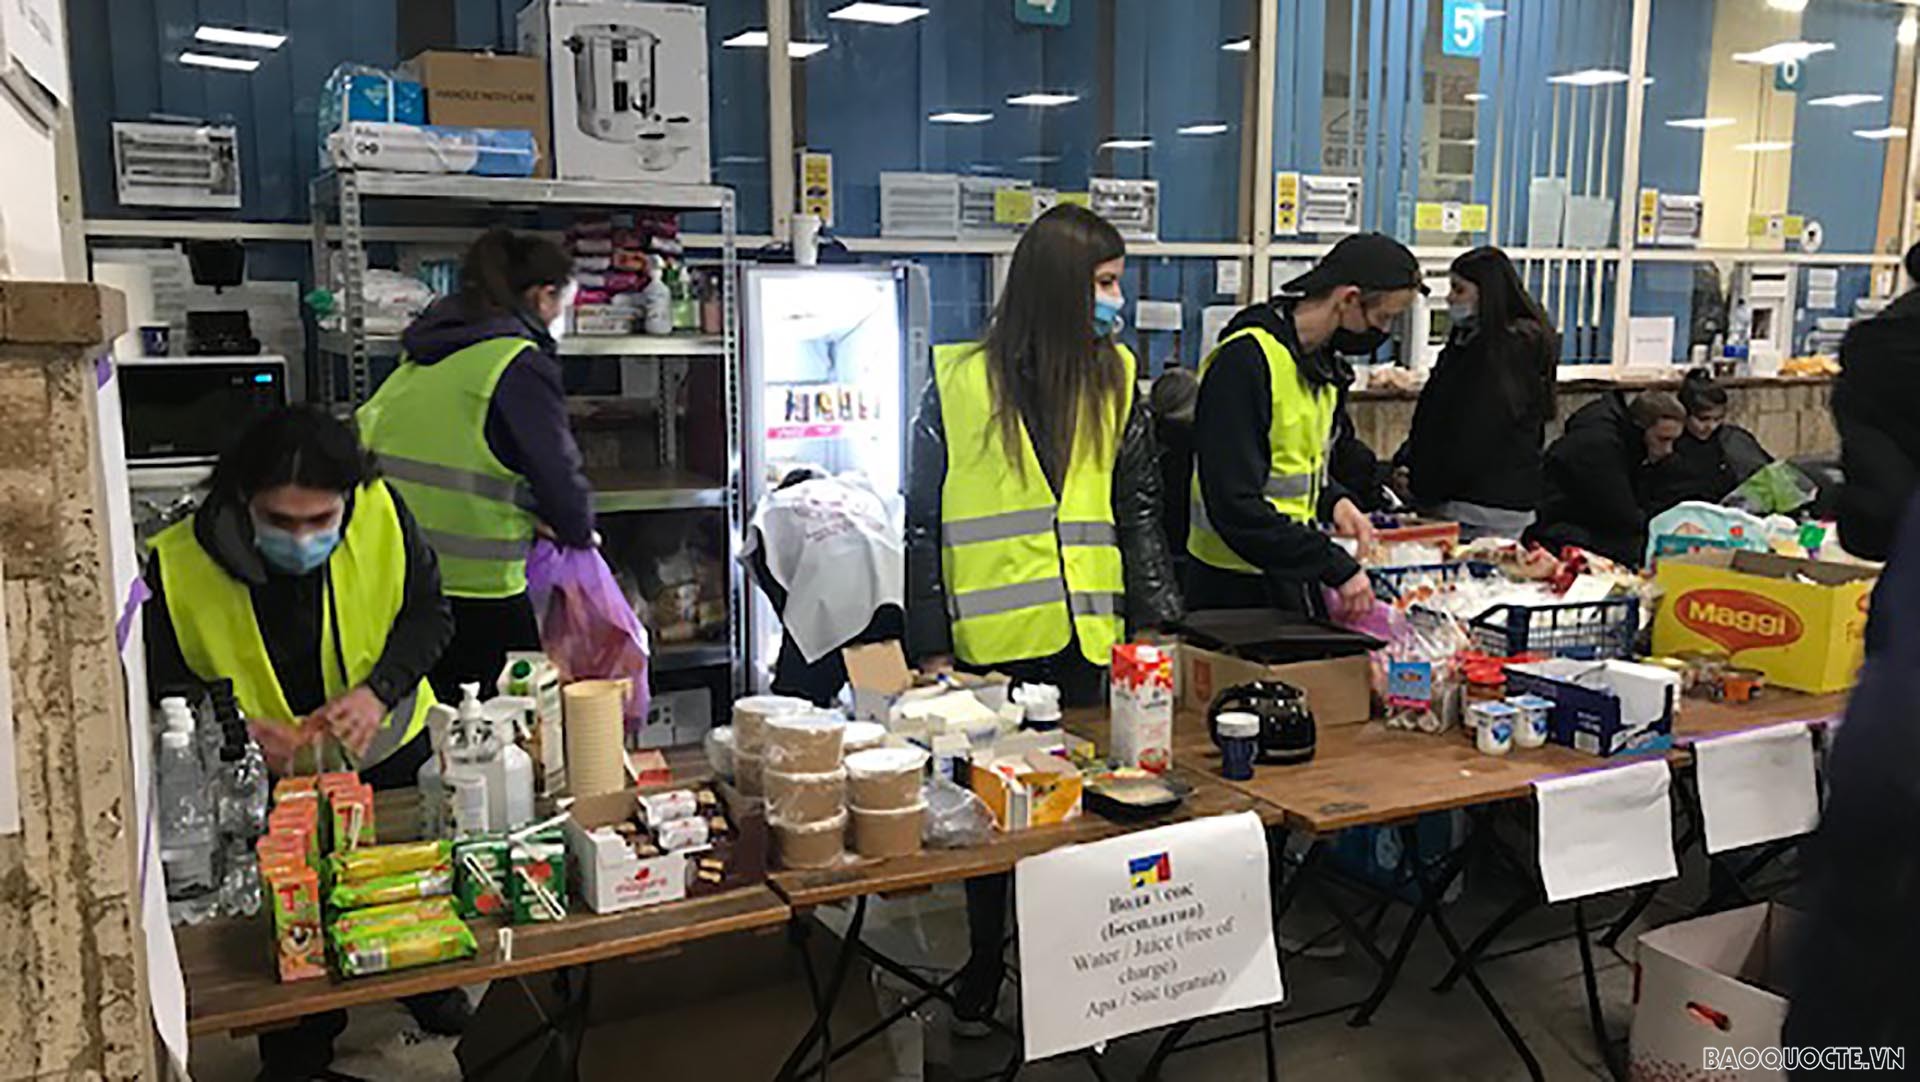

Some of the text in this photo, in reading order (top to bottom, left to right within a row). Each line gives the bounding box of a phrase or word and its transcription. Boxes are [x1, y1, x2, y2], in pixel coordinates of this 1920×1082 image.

[1454, 8, 1476, 47] 5
[1688, 600, 1786, 637] Maggi
[1072, 949, 1119, 971] Water
[1134, 937, 1174, 958] Juice
[1216, 916, 1236, 936] of
[1118, 957, 1178, 984] charge)
[1086, 999, 1117, 1018] Apa
